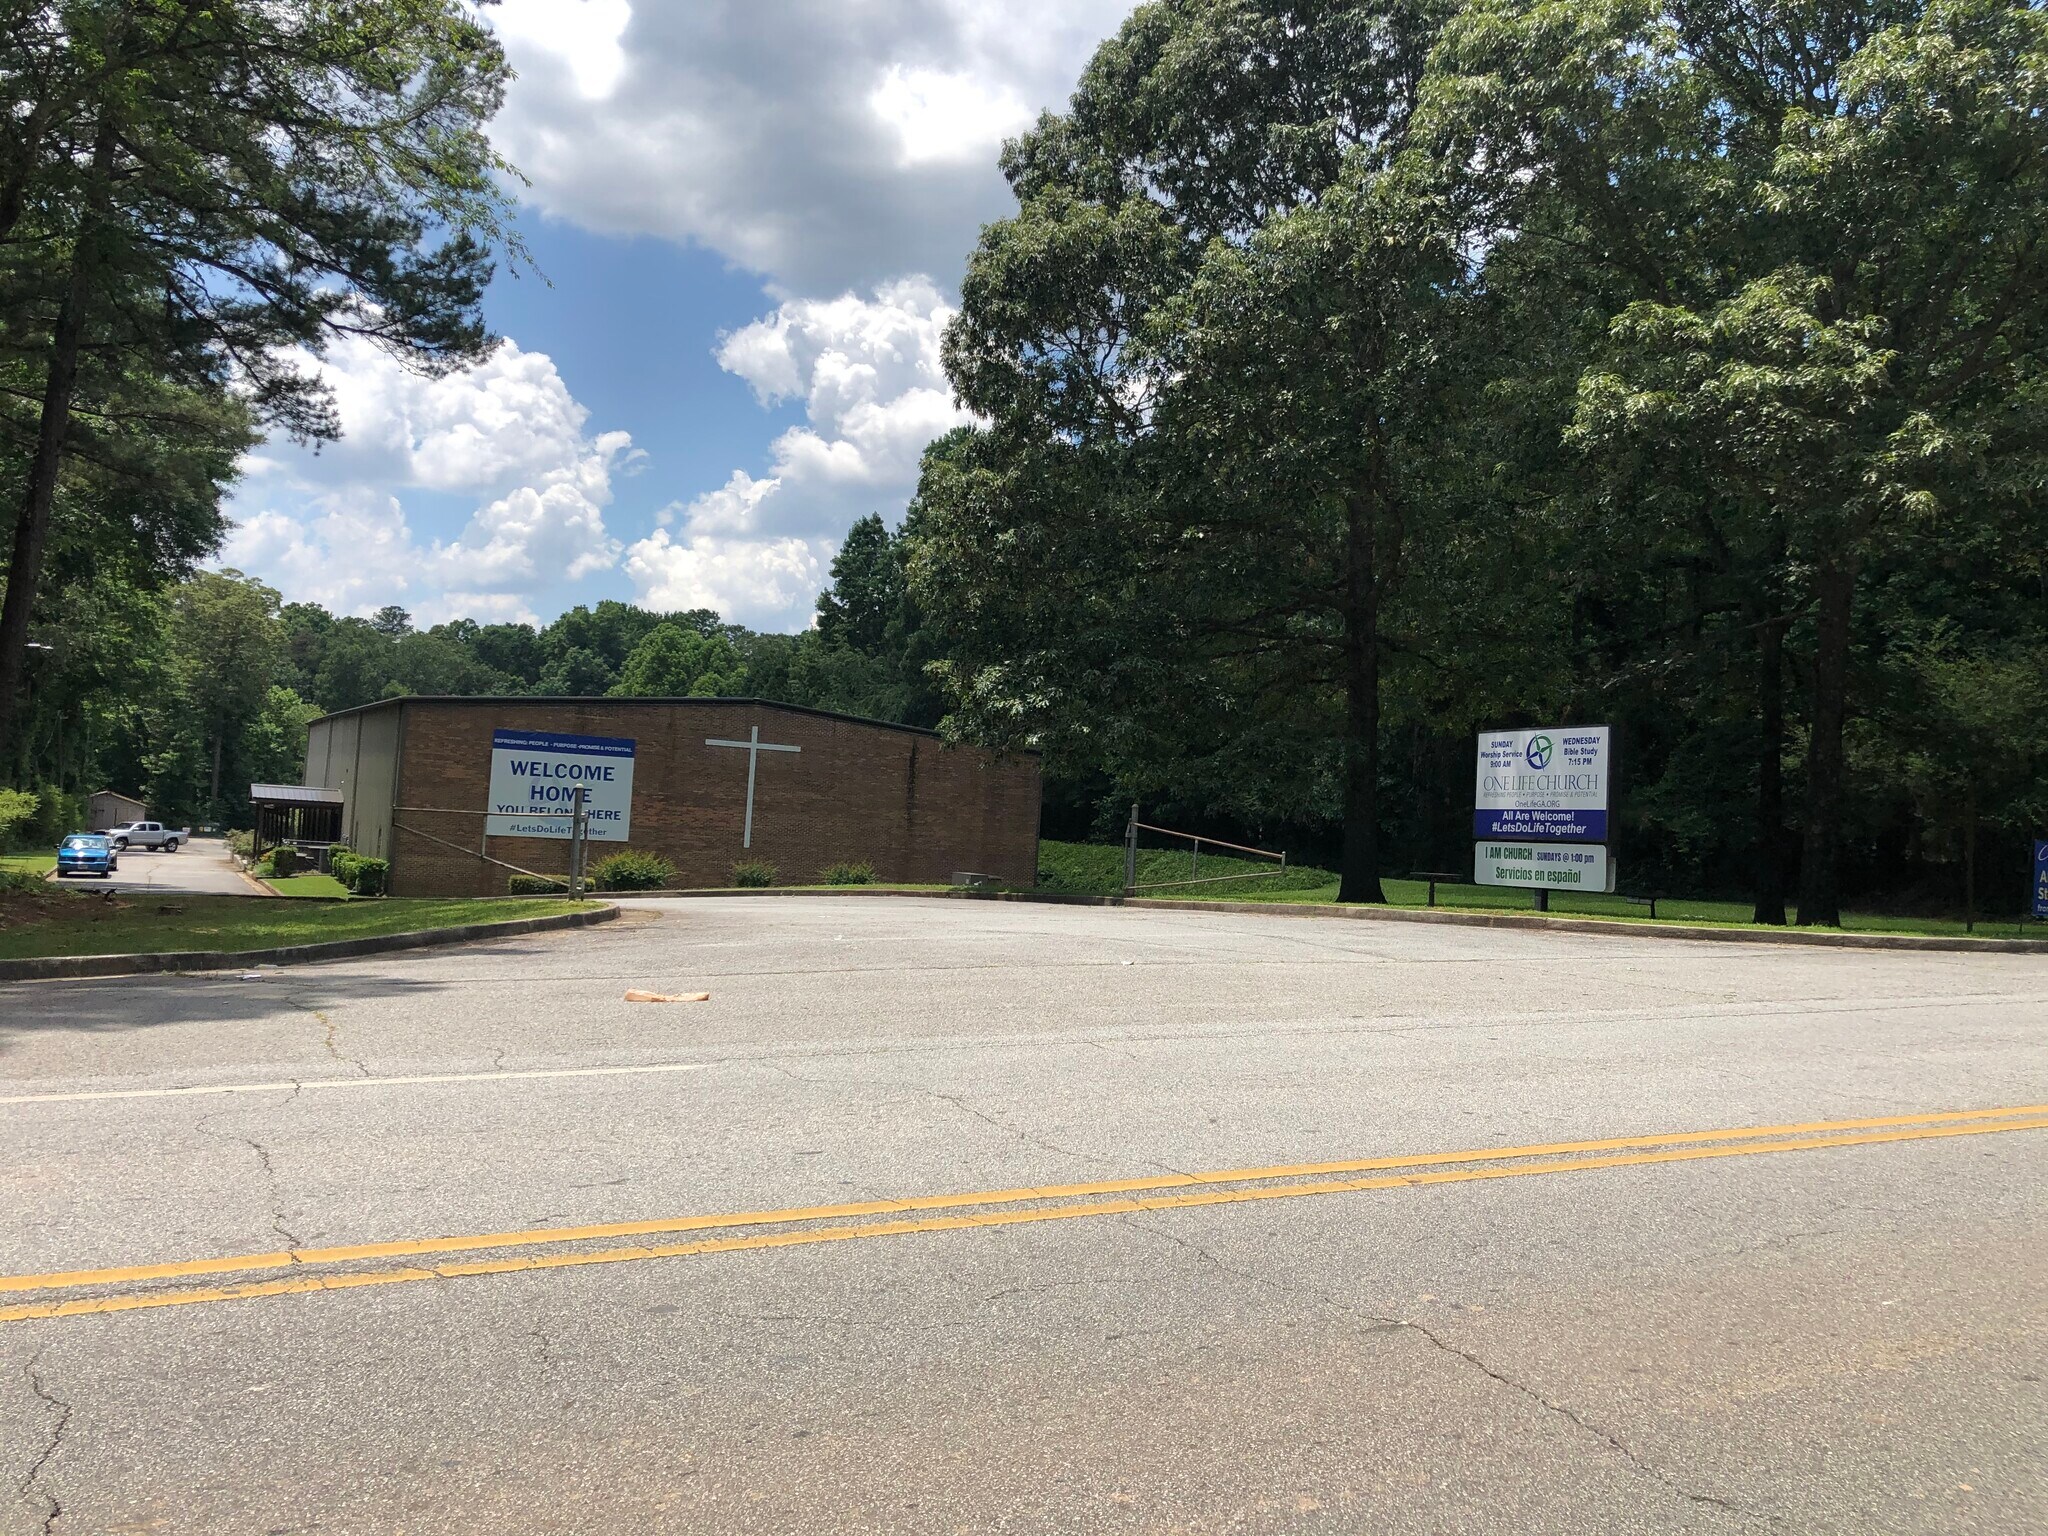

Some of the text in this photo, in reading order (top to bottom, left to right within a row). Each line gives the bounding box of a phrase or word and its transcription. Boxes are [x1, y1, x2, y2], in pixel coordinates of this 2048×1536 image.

[1562, 736, 1600, 745] WEDNESDAY
[1480, 750, 1522, 759] Worship Service
[1580, 748, 1598, 756] Study
[510, 760, 615, 781] WELCOME
[1483, 774, 1598, 791] ONE LIFE CHURCH
[530, 785, 592, 803] HOME
[530, 806, 576, 816] BELON
[587, 810, 622, 820] HERE
[1502, 810, 1574, 821] All Are Welcome!
[510, 824, 608, 836] #LetsDoLifeTther
[1492, 822, 1586, 835] #LetsDoLifeTogether
[1486, 846, 1594, 864] I AM CHURCH SUNDAYS @ 1:00 pm
[1496, 866, 1581, 884] Servicios en español
